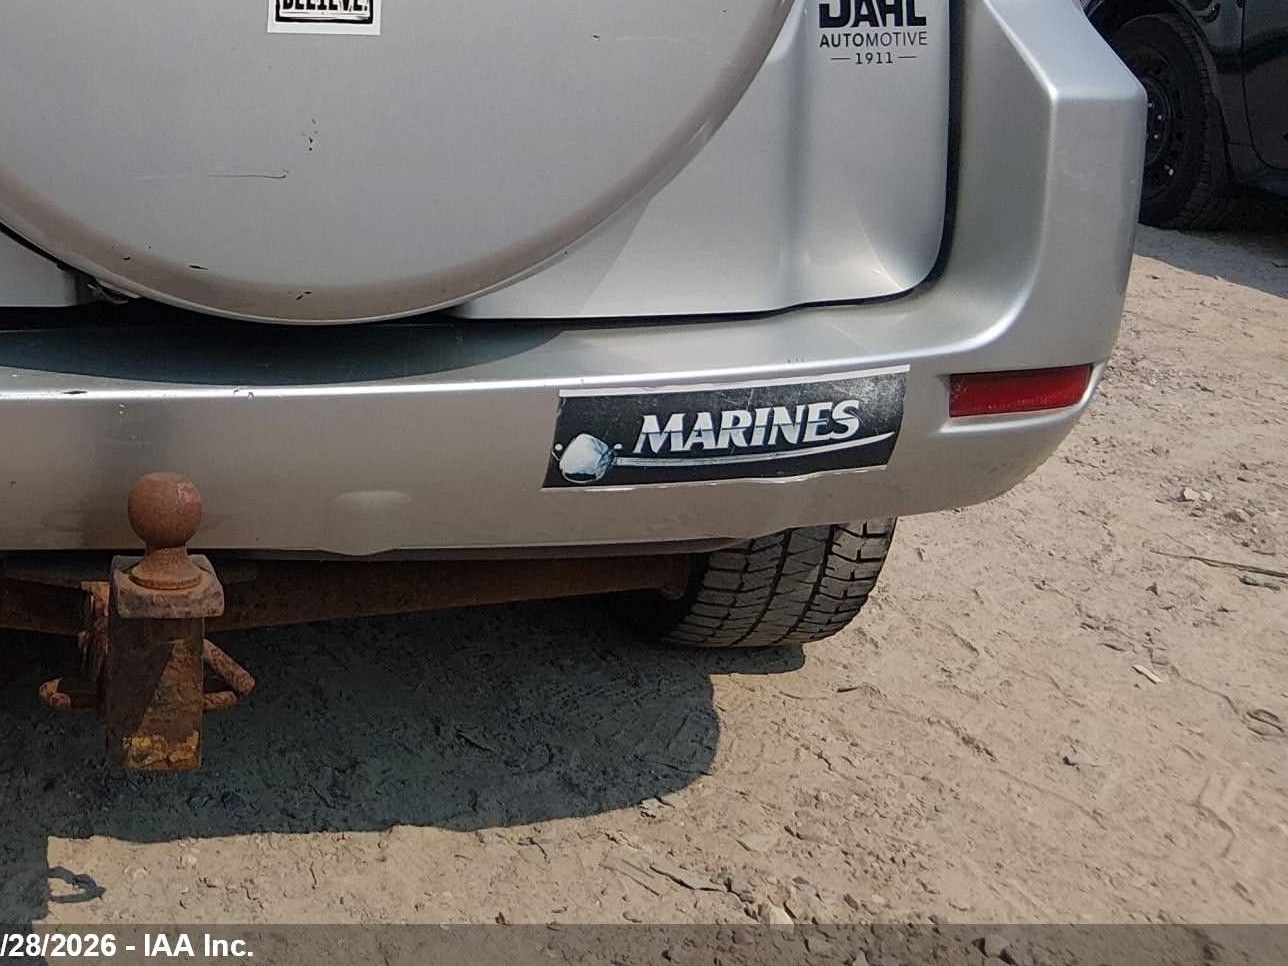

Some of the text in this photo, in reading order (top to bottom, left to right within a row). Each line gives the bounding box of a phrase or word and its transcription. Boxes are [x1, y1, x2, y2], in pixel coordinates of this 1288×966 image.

[818, 31, 929, 48] AUTOMOTIVE
[854, 51, 894, 65] 1911
[632, 399, 861, 454] MARINES
